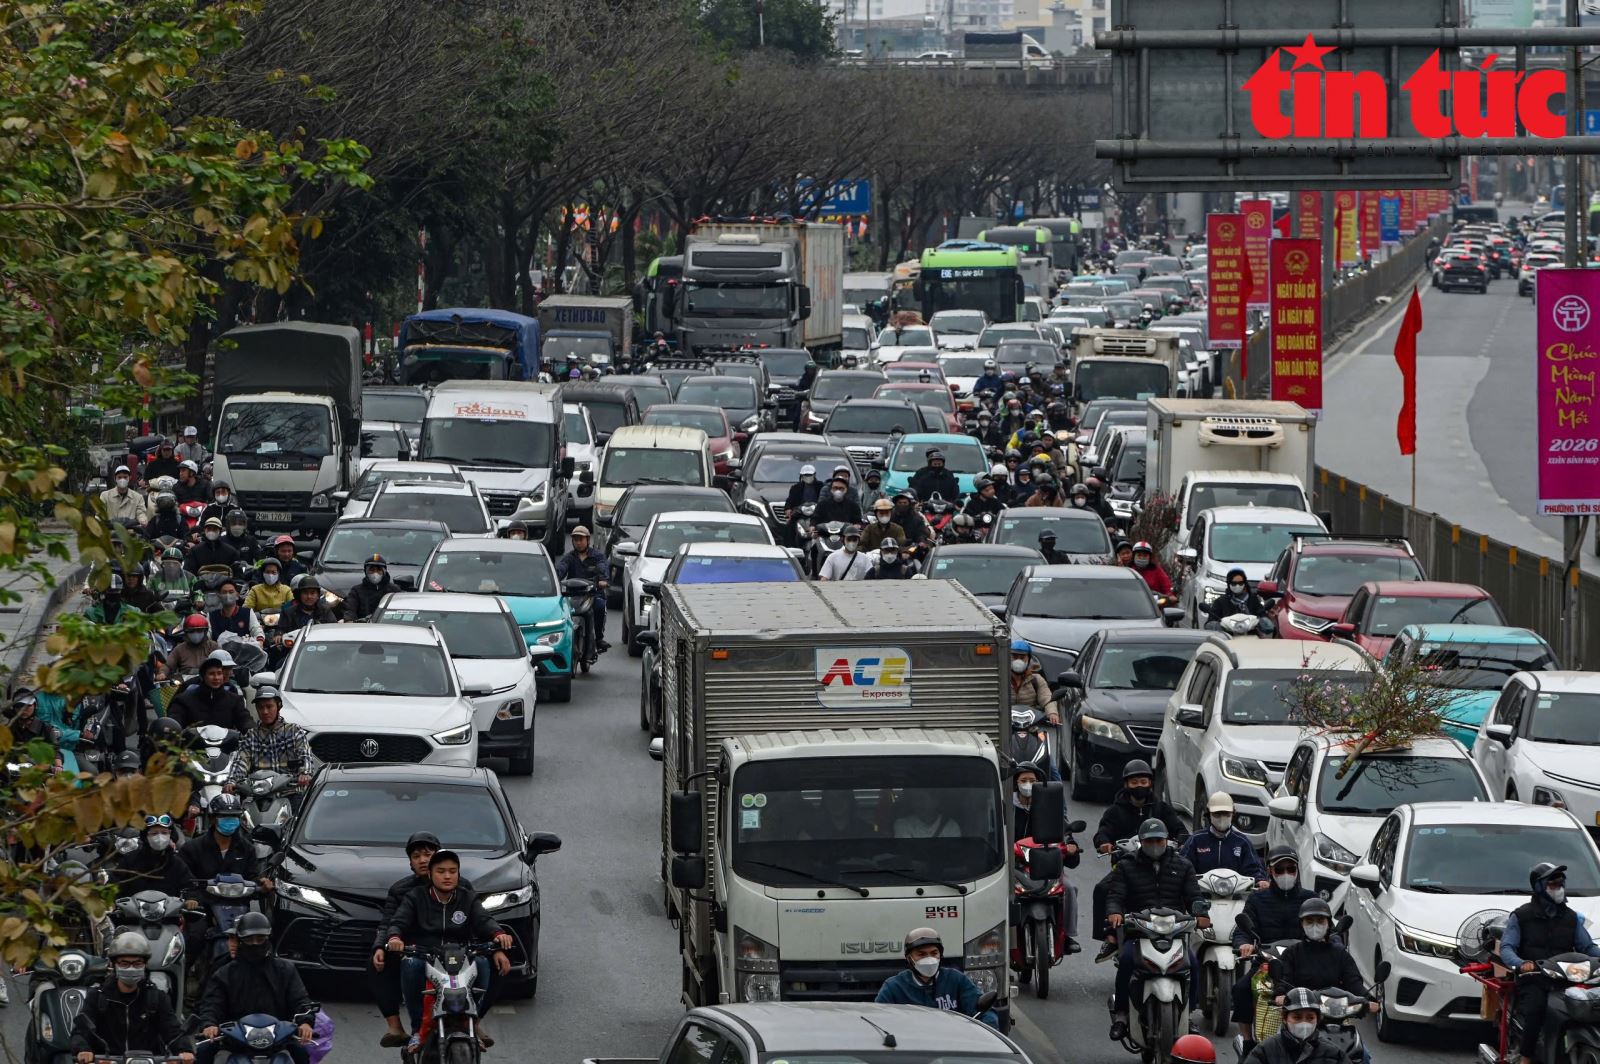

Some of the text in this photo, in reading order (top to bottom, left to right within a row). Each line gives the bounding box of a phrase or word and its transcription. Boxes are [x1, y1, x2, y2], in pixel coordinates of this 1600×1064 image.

[1276, 278, 1316, 299] NGÀY BẦU CỬ
[1278, 307, 1314, 328] LÀ NGÀY HỘI
[1276, 331, 1316, 353] ĐẠI ĐOÀN KẾT
[1545, 343, 1599, 361] Chúc
[1274, 358, 1291, 377] TOÀN
[1292, 358, 1304, 377] DÂN
[1551, 365, 1596, 397] Mừng
[1555, 386, 1592, 407] Năm
[1558, 408, 1589, 429] Mới
[1549, 438, 1599, 452] 2026
[260, 462, 289, 470] ISUZU
[1544, 503, 1575, 513] PHƯỜNG
[1576, 502, 1591, 513] YÊN
[821, 658, 907, 686] ACE
[862, 689, 903, 699] Express
[840, 941, 903, 954] ISUZU
